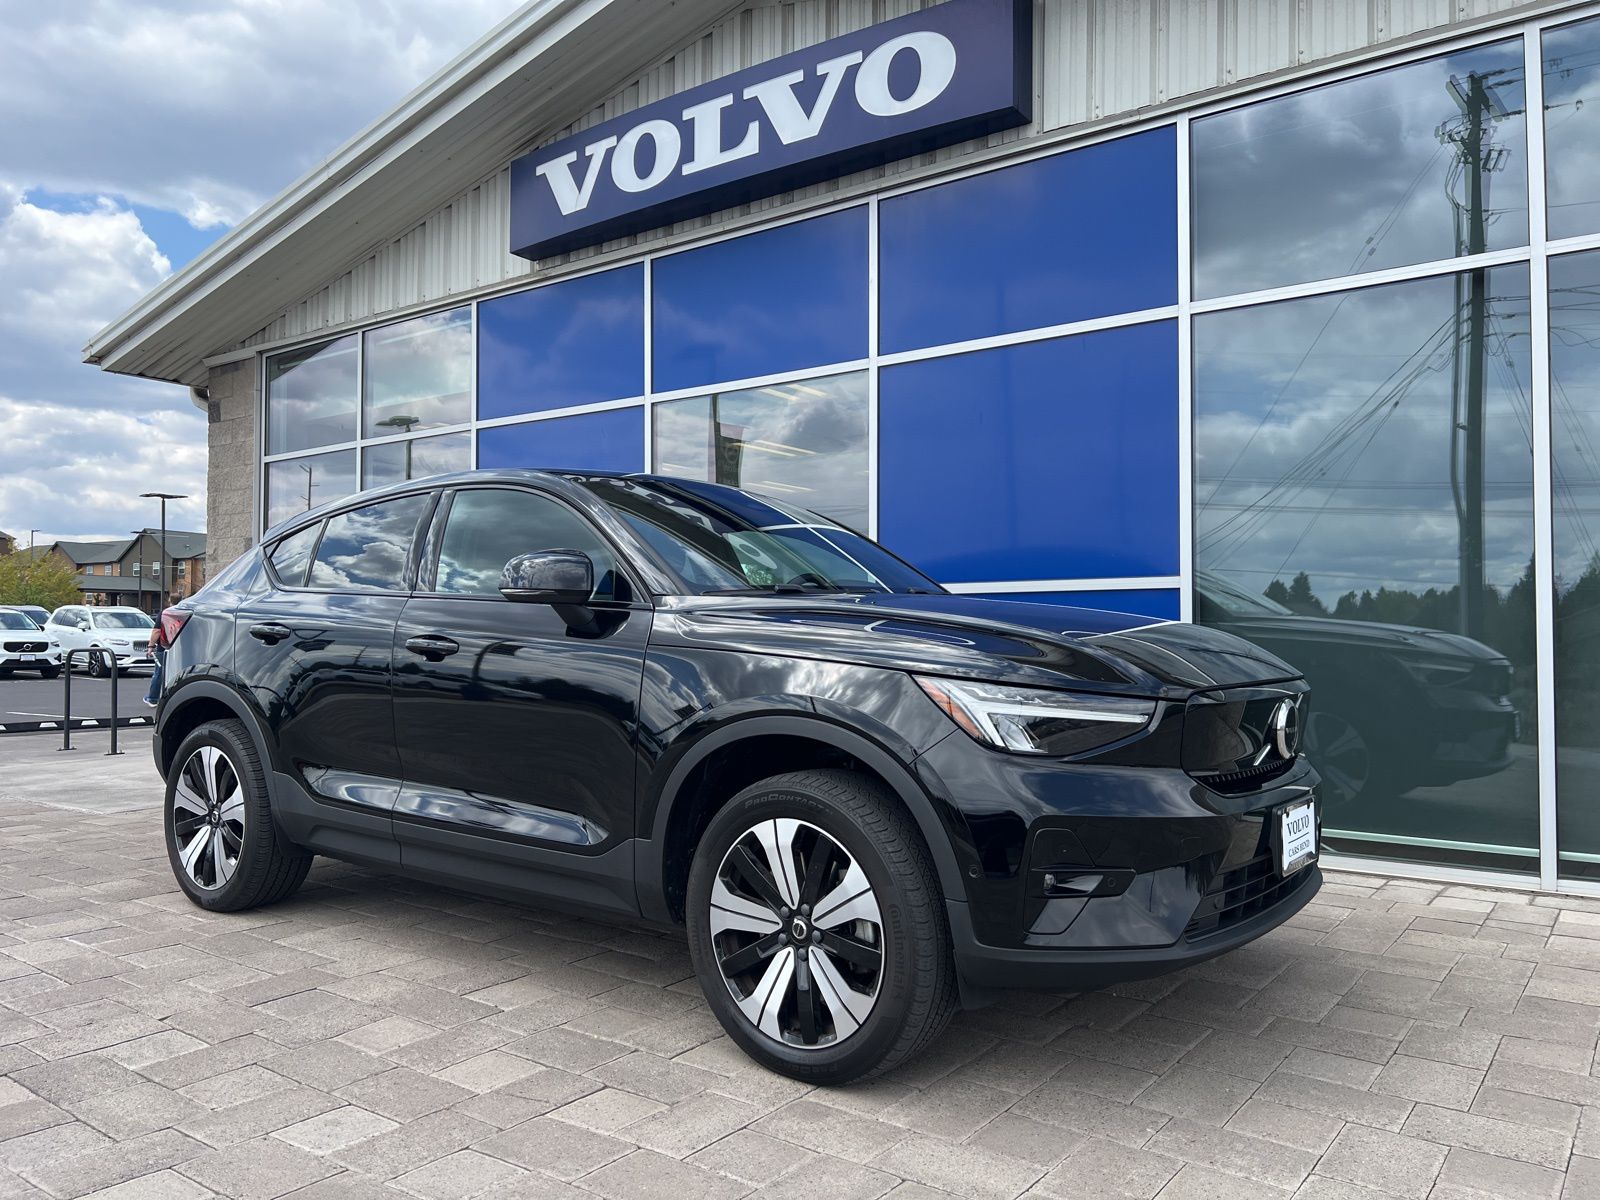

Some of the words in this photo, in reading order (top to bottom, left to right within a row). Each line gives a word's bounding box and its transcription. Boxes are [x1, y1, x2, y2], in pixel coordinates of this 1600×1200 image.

[535, 31, 957, 216] VOLVO
[1286, 814, 1310, 837] VOLVO
[1288, 844, 1300, 858] CARS
